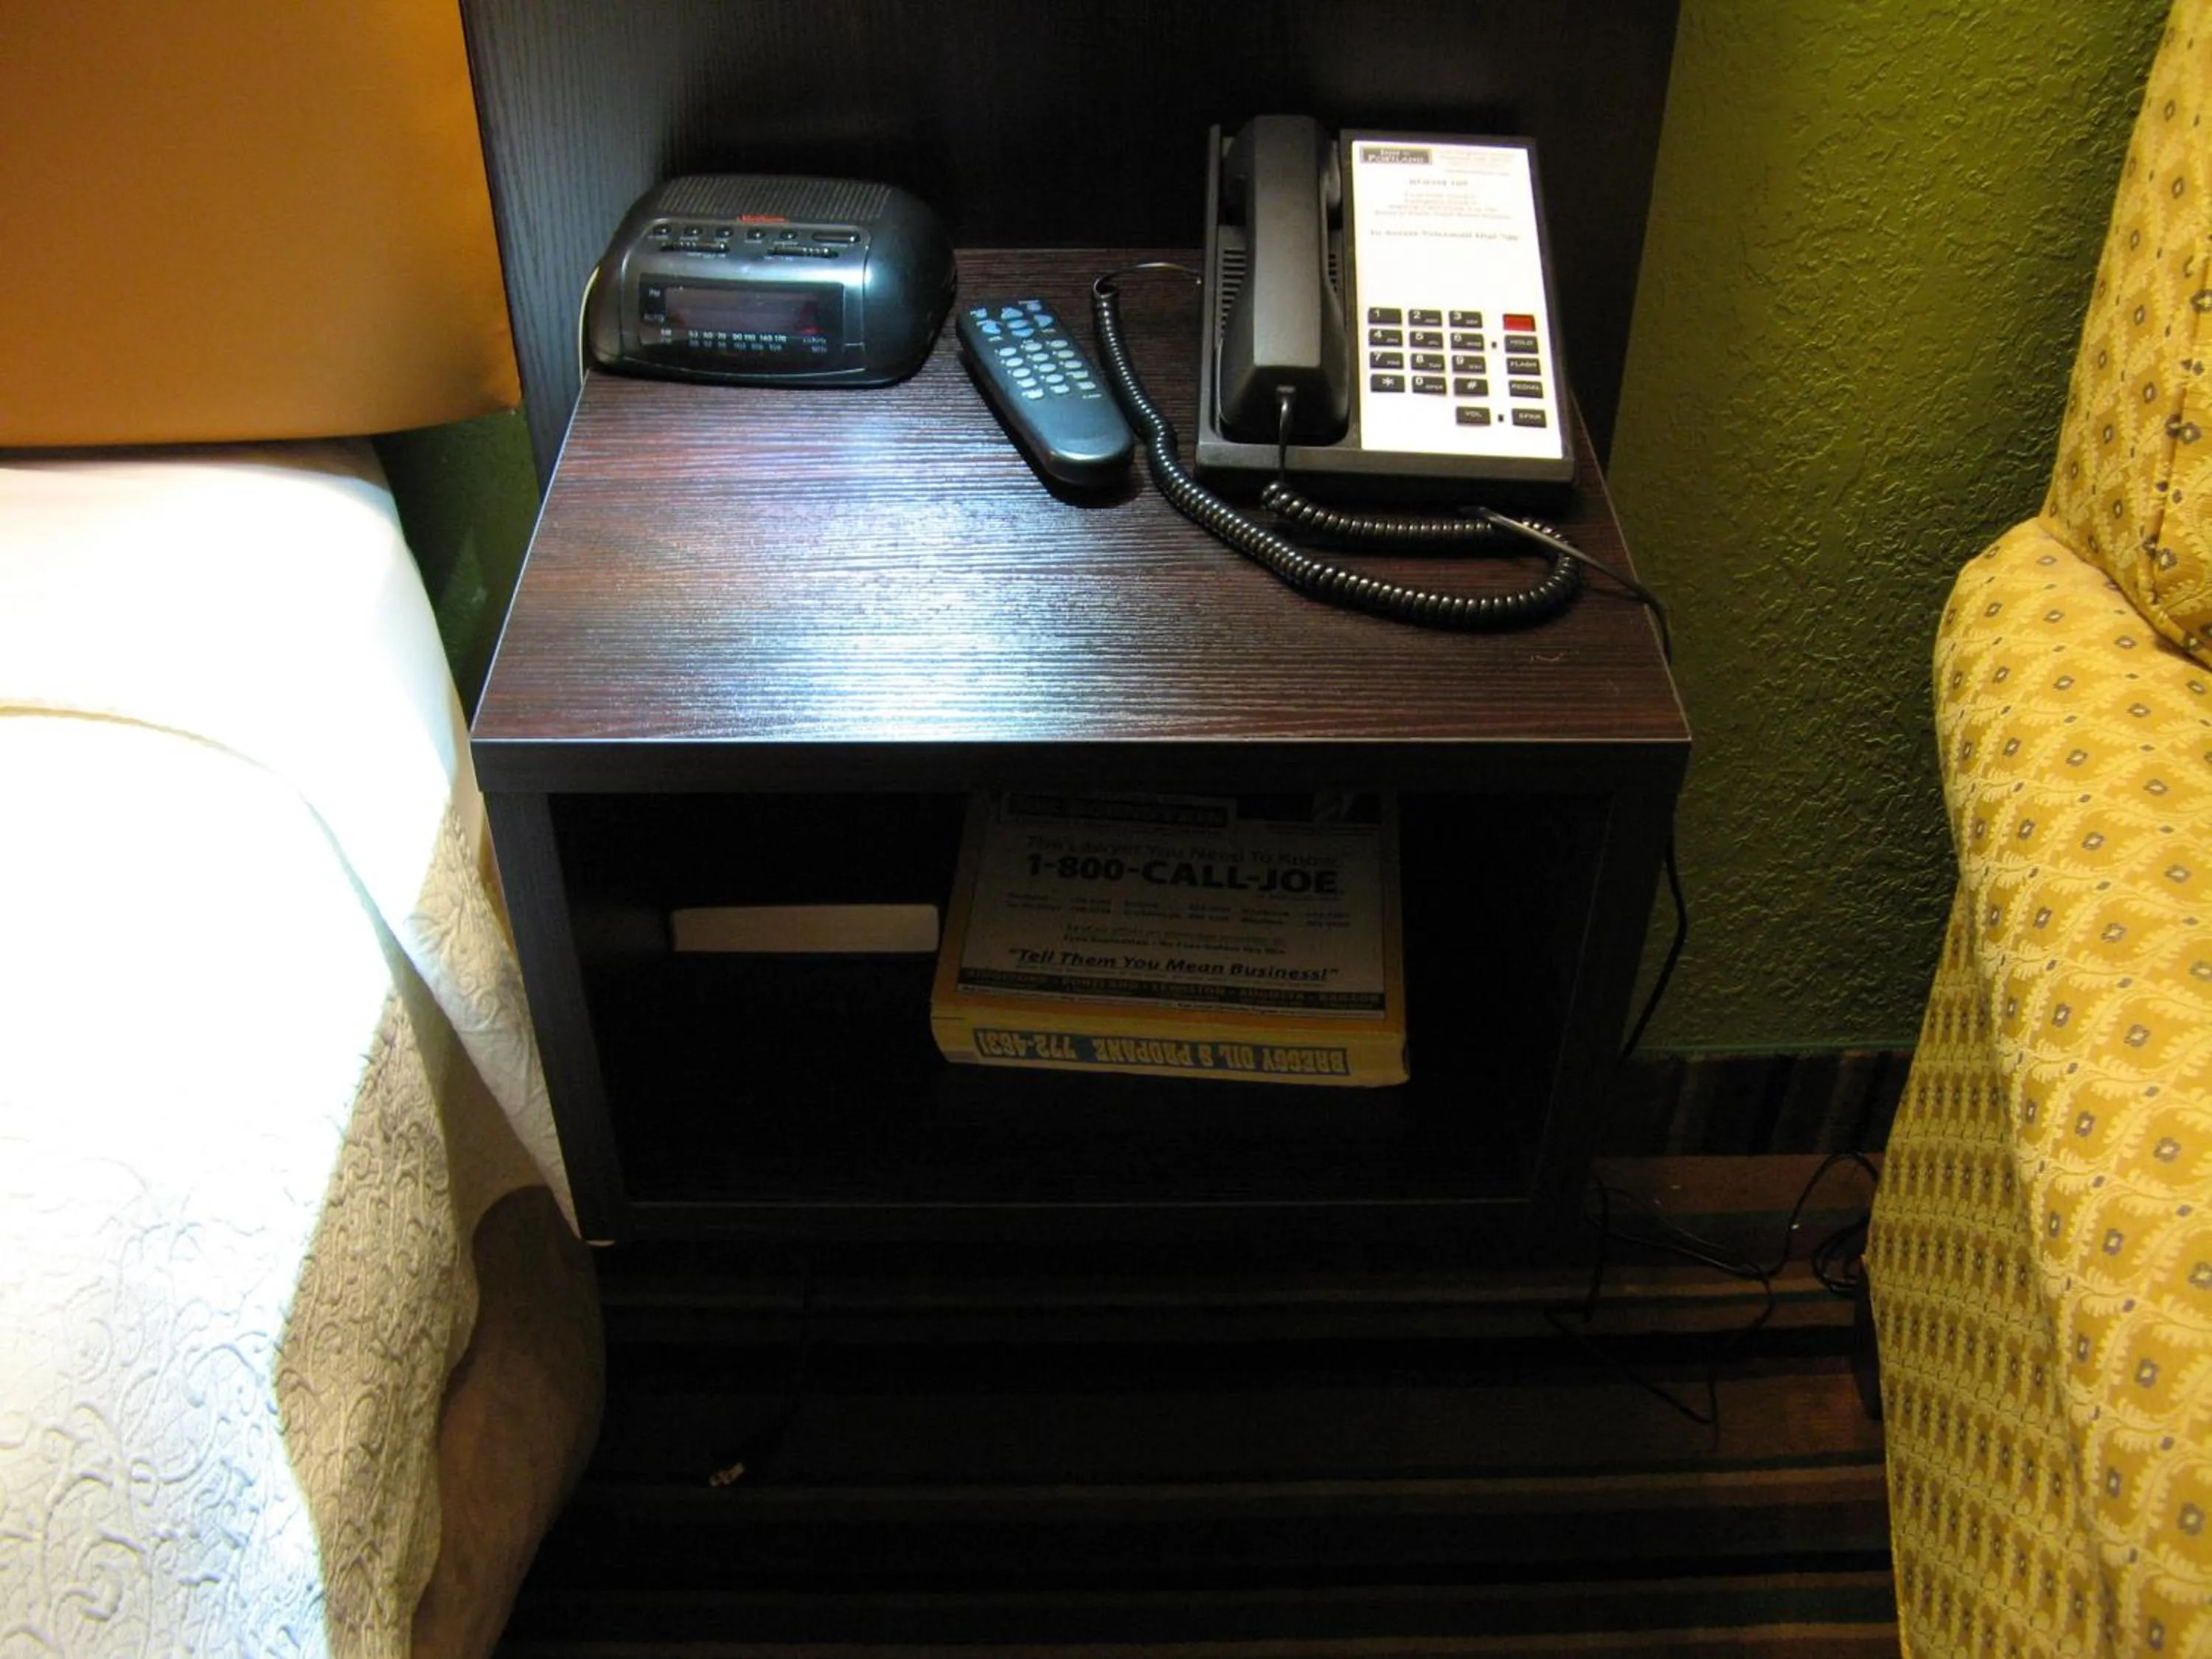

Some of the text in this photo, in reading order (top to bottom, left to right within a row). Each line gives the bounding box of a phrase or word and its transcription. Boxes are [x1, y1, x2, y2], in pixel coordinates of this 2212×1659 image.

[1374, 310, 1380, 318] 1
[1413, 310, 1421, 319] 2
[1454, 311, 1462, 320] 3
[1374, 330, 1382, 338] 4
[1415, 332, 1424, 341] 5
[1453, 334, 1462, 342] 6
[1374, 352, 1381, 362] 7
[1416, 354, 1424, 364] 8
[1455, 355, 1464, 365] 9
[1416, 377, 1424, 386] 0
[1192, 844, 1245, 863] Need
[1252, 849, 1273, 863] To
[1026, 852, 1338, 894] 1-800-CALL-JOE
[1060, 950, 1116, 967] Them
[1123, 956, 1161, 971] You
[1165, 959, 1225, 974] Mean
[1229, 962, 1340, 981] Business!"
[1091, 1037, 1194, 1066] PROPANE
[1218, 1043, 1256, 1069] OIL
